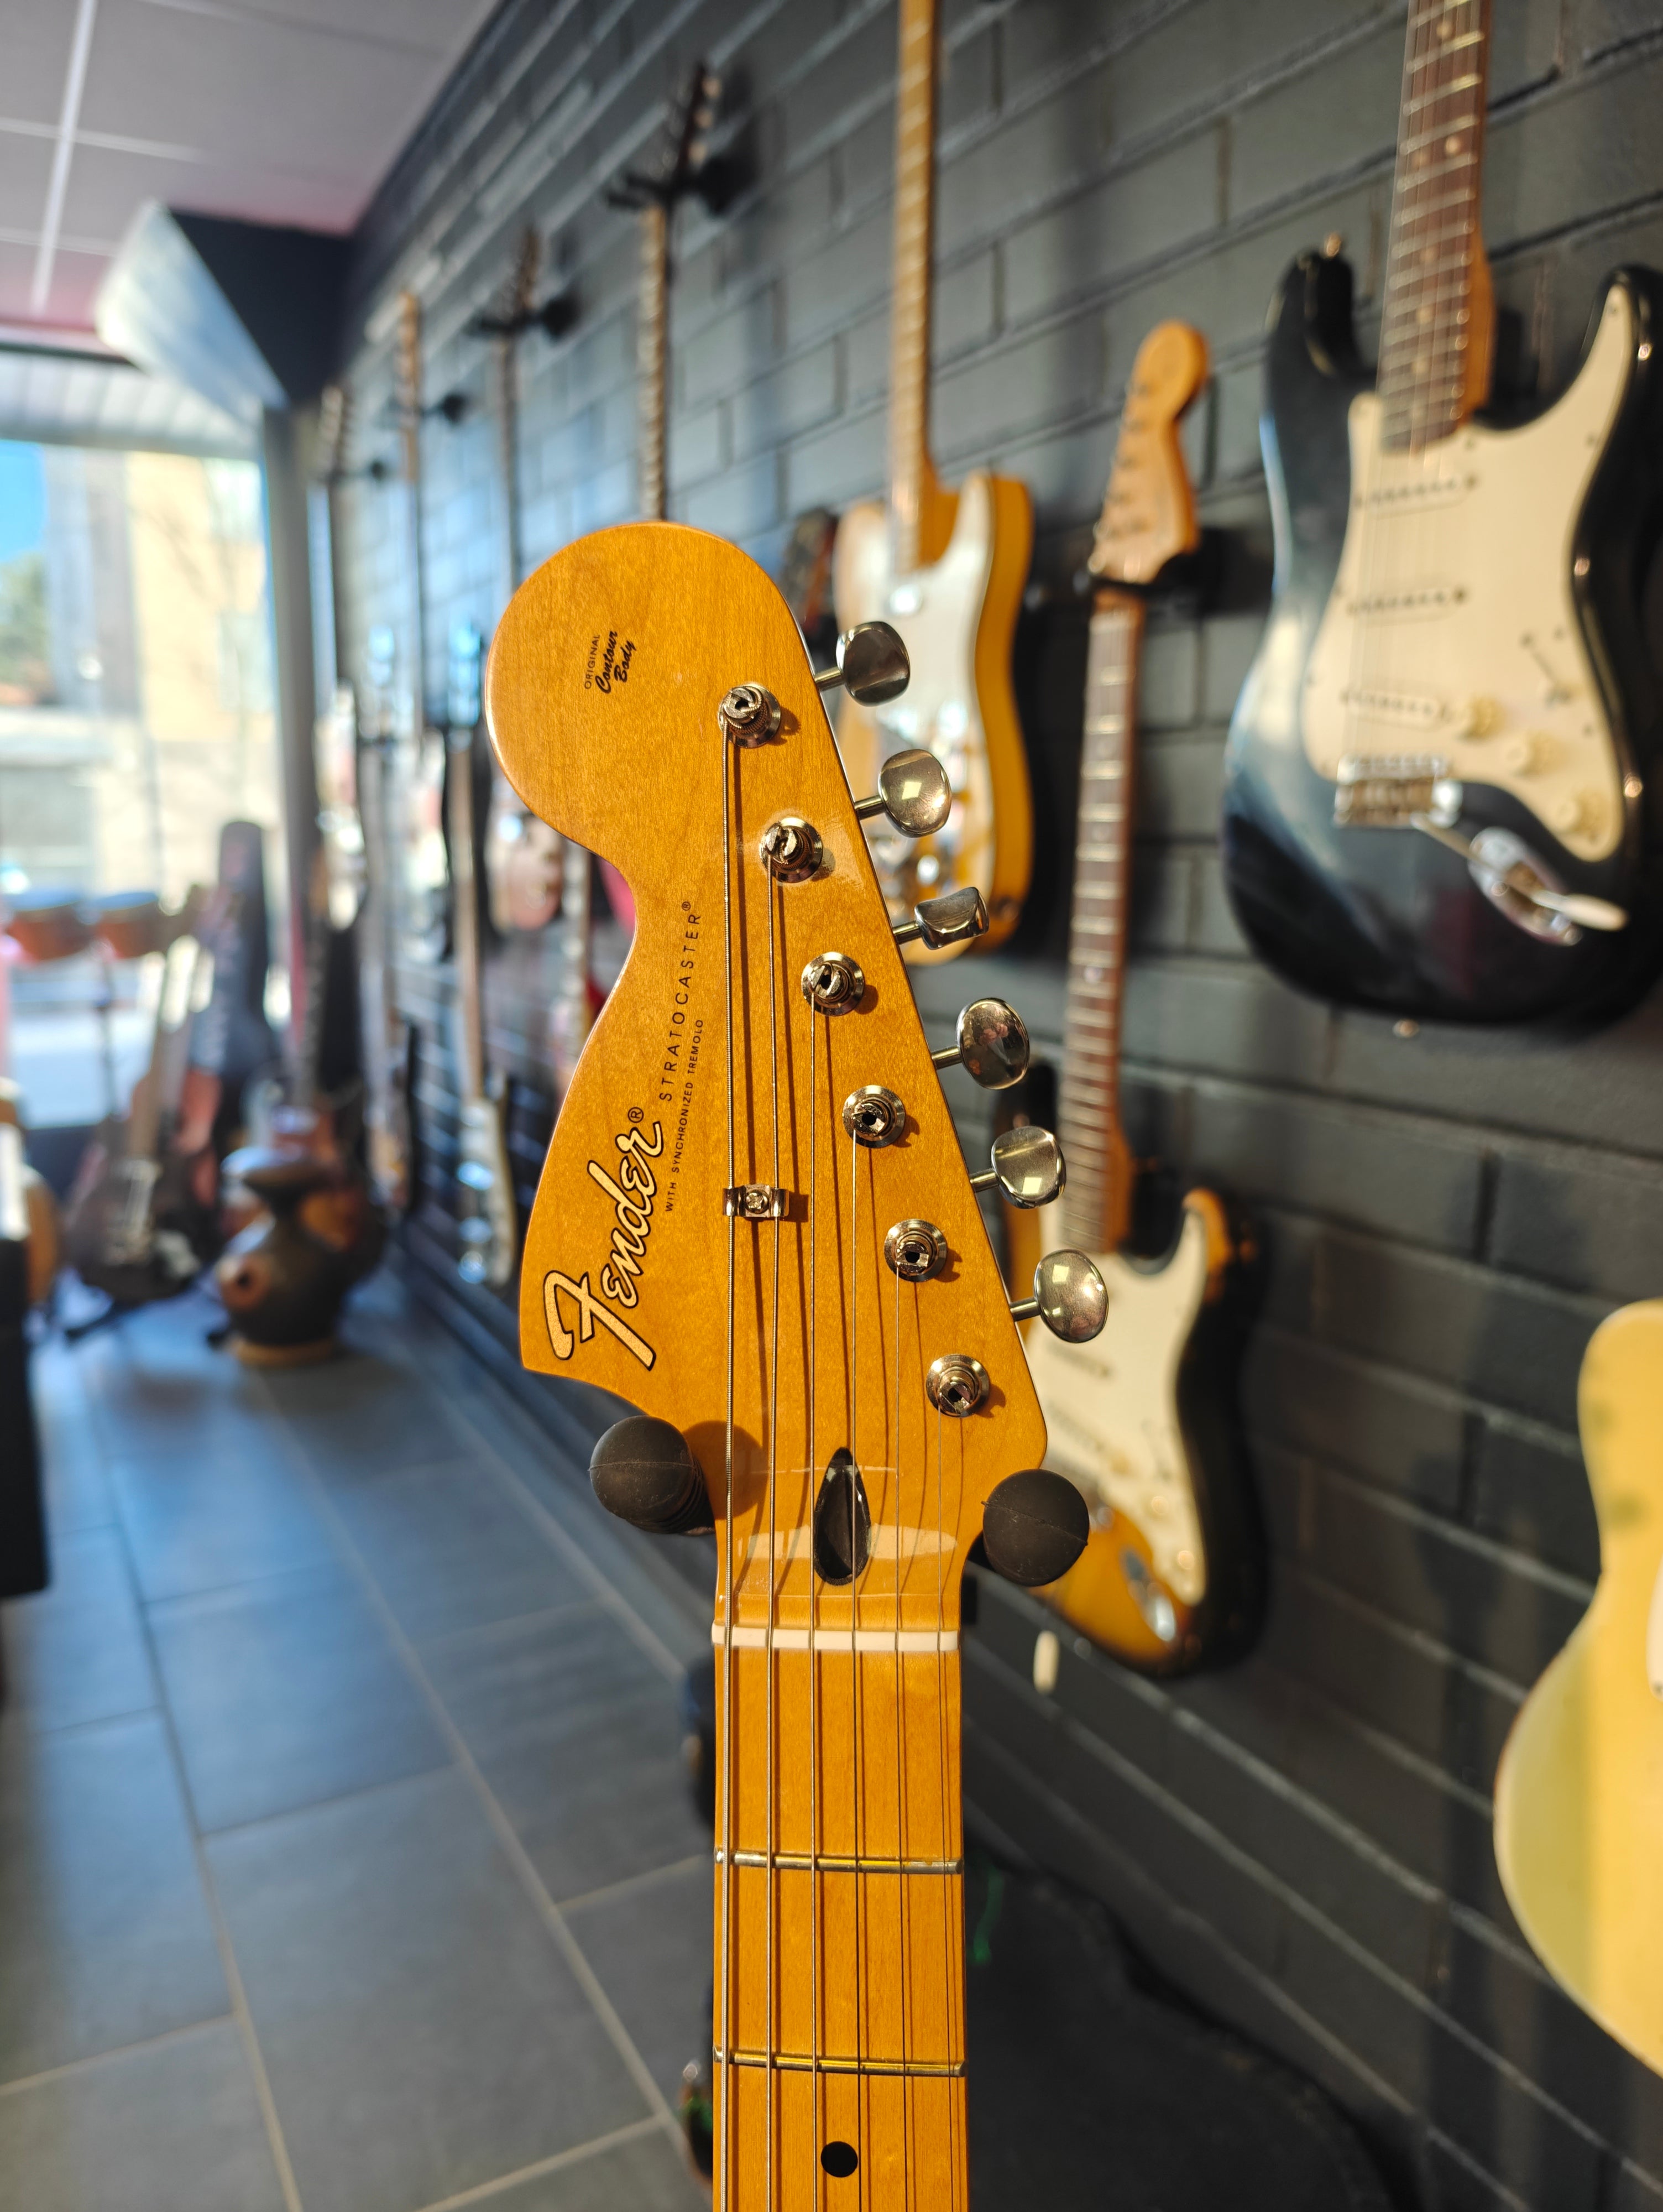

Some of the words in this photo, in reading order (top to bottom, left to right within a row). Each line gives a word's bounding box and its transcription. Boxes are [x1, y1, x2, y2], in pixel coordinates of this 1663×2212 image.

[584, 635, 600, 690] ORIGINAL
[595, 631, 618, 693] Contour
[614, 640, 636, 682] Body
[665, 1182, 676, 1212] WITH
[672, 1078, 693, 1174] SYNCHRONIZED
[689, 1019, 704, 1075] TREMOLO
